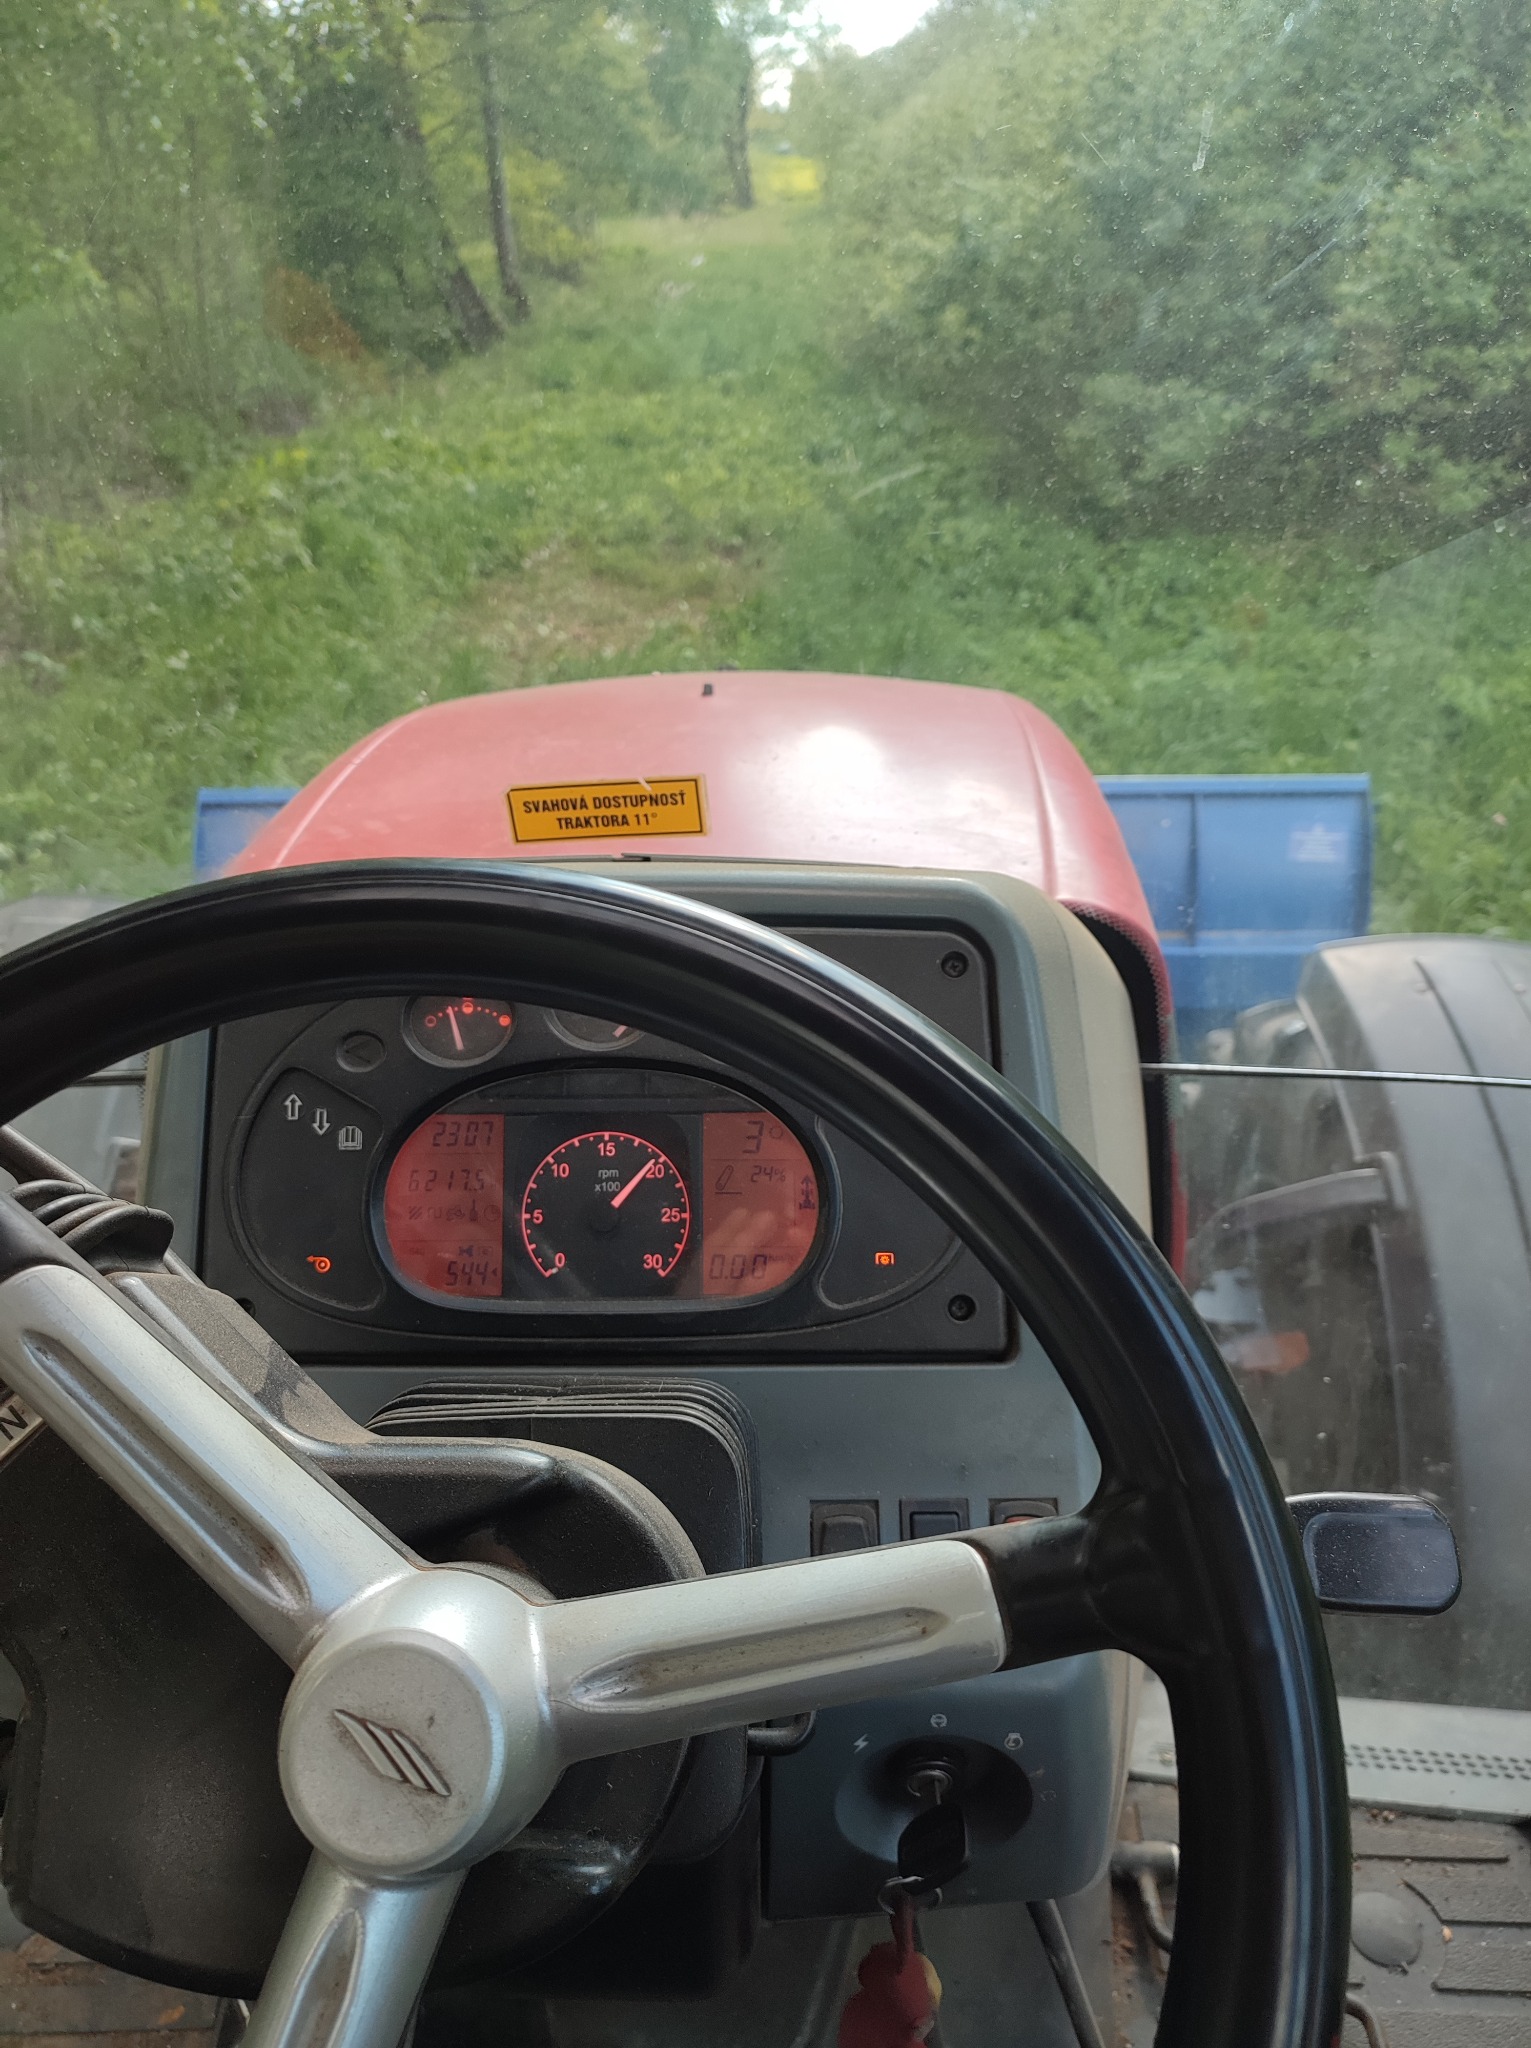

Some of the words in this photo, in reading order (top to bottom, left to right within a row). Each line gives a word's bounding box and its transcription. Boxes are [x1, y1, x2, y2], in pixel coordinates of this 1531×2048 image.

[523, 795, 589, 814] SVAHOVÁ
[593, 790, 686, 810] DOSTUPNOSŤ
[556, 814, 630, 830] TRAKTORA
[432, 1121, 494, 1147] 2307
[597, 1142, 616, 1157] 15
[551, 1164, 570, 1178] 10
[598, 1169, 619, 1179] rpm
[645, 1164, 665, 1178] 20
[594, 1182, 621, 1192] x100
[532, 1209, 544, 1224] 5
[661, 1208, 681, 1223] 25
[554, 1252, 566, 1267] 0
[643, 1254, 663, 1269] 30
[445, 1261, 489, 1287] 544
